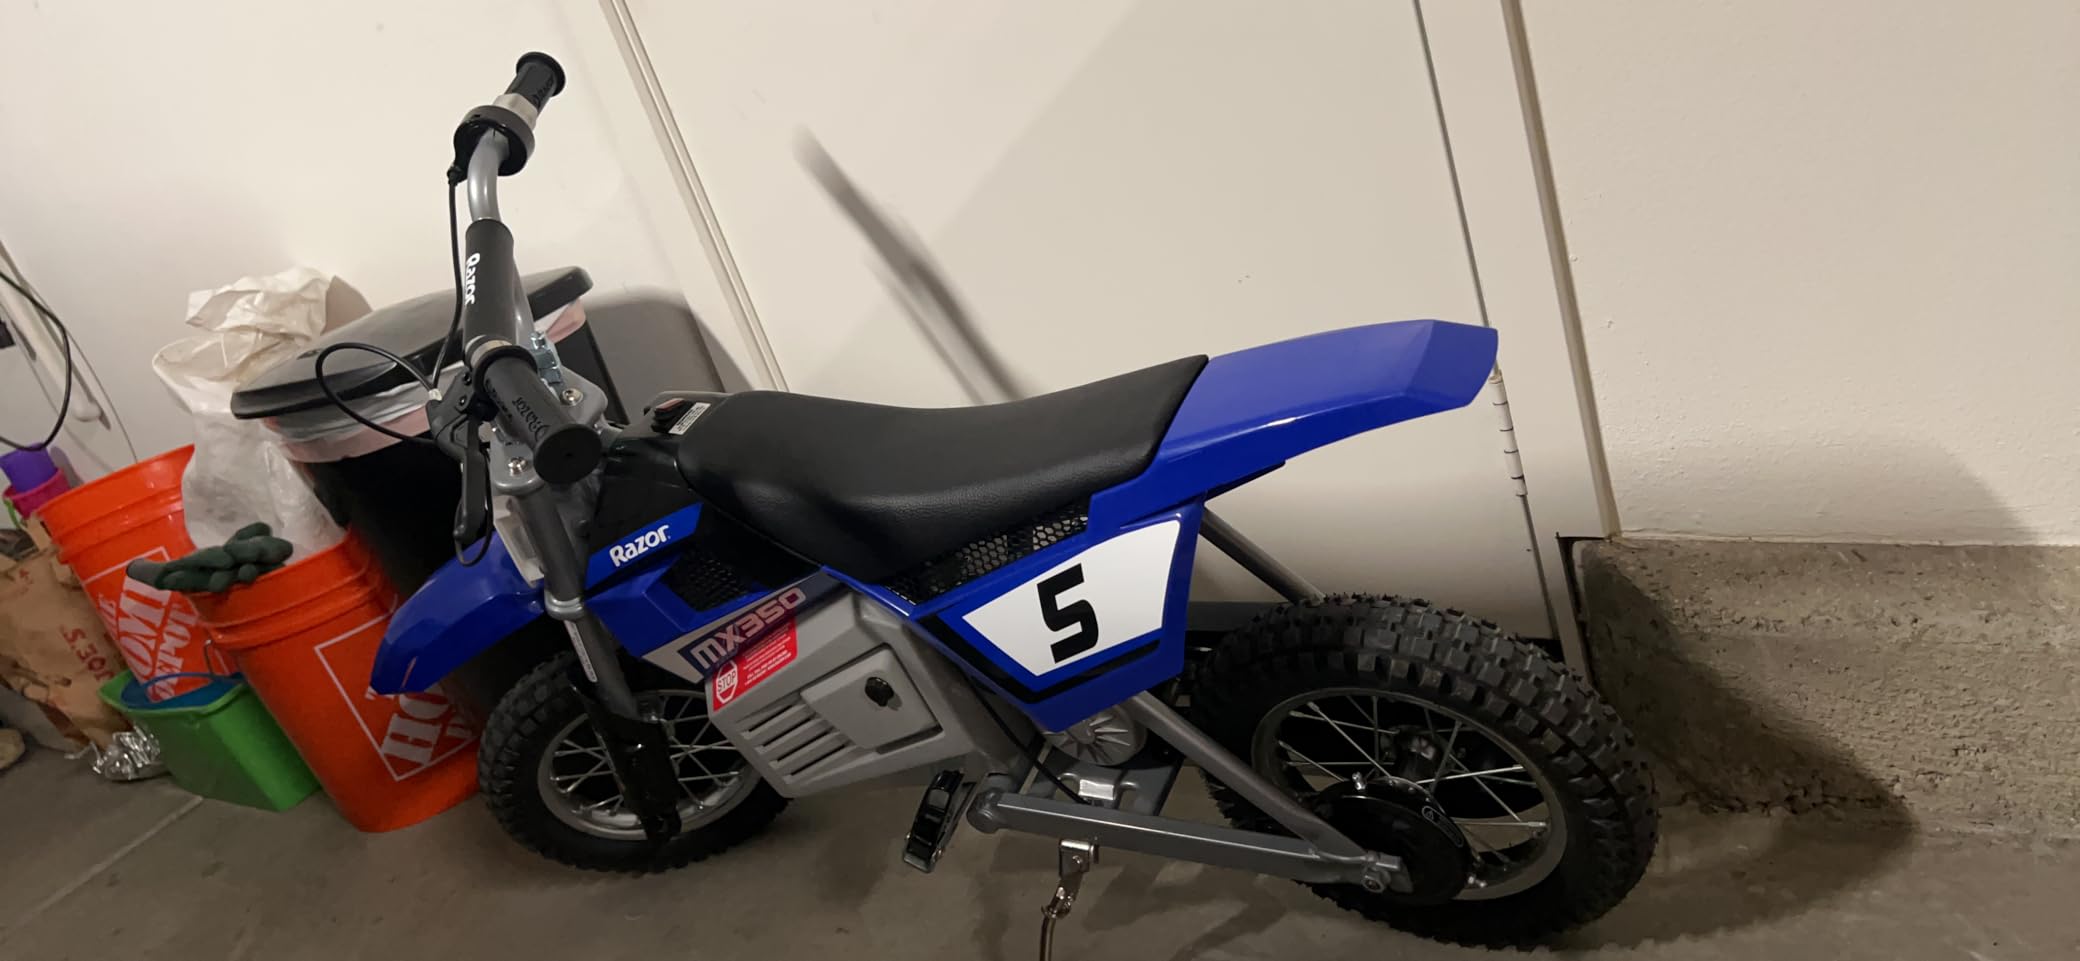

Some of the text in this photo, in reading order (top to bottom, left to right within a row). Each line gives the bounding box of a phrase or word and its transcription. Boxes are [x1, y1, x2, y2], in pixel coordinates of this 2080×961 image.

[465, 252, 481, 305] Razor
[609, 524, 670, 567] Razor
[690, 587, 806, 669] MX350
[1036, 562, 1099, 664] 5
[717, 669, 738, 693] STOP
[380, 681, 450, 766] HO
